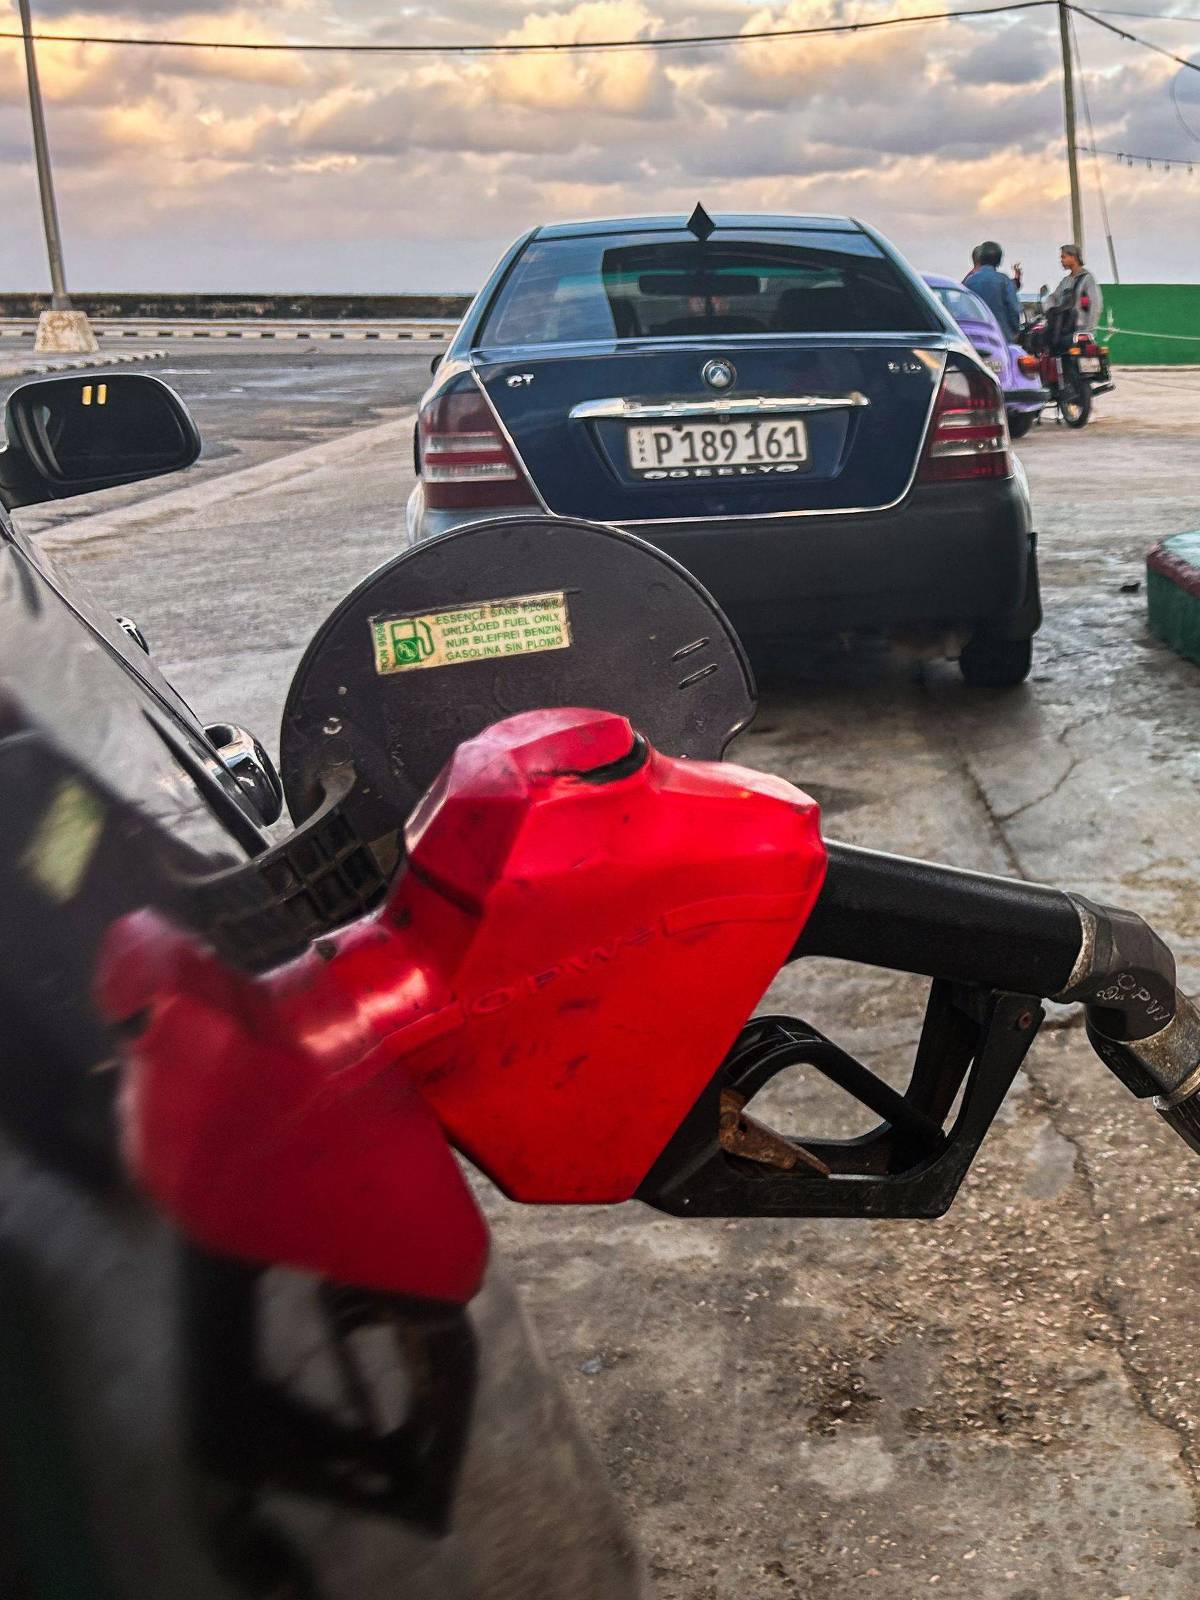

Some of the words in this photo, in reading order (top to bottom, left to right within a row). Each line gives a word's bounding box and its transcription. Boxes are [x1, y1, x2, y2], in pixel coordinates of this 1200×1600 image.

[436, 610, 487, 625] ESSENCE
[490, 605, 519, 618] SANS
[442, 620, 500, 636] UNLEADED
[504, 617, 530, 628] FUEL
[534, 612, 560, 624] ONLY
[446, 637, 469, 648] NUR
[473, 630, 520, 645] BLEIFREI
[524, 623, 562, 638] BENZIN
[446, 645, 502, 661] GASOLINA
[505, 641, 523, 652] SIN
[526, 635, 563, 649] PLOMO
